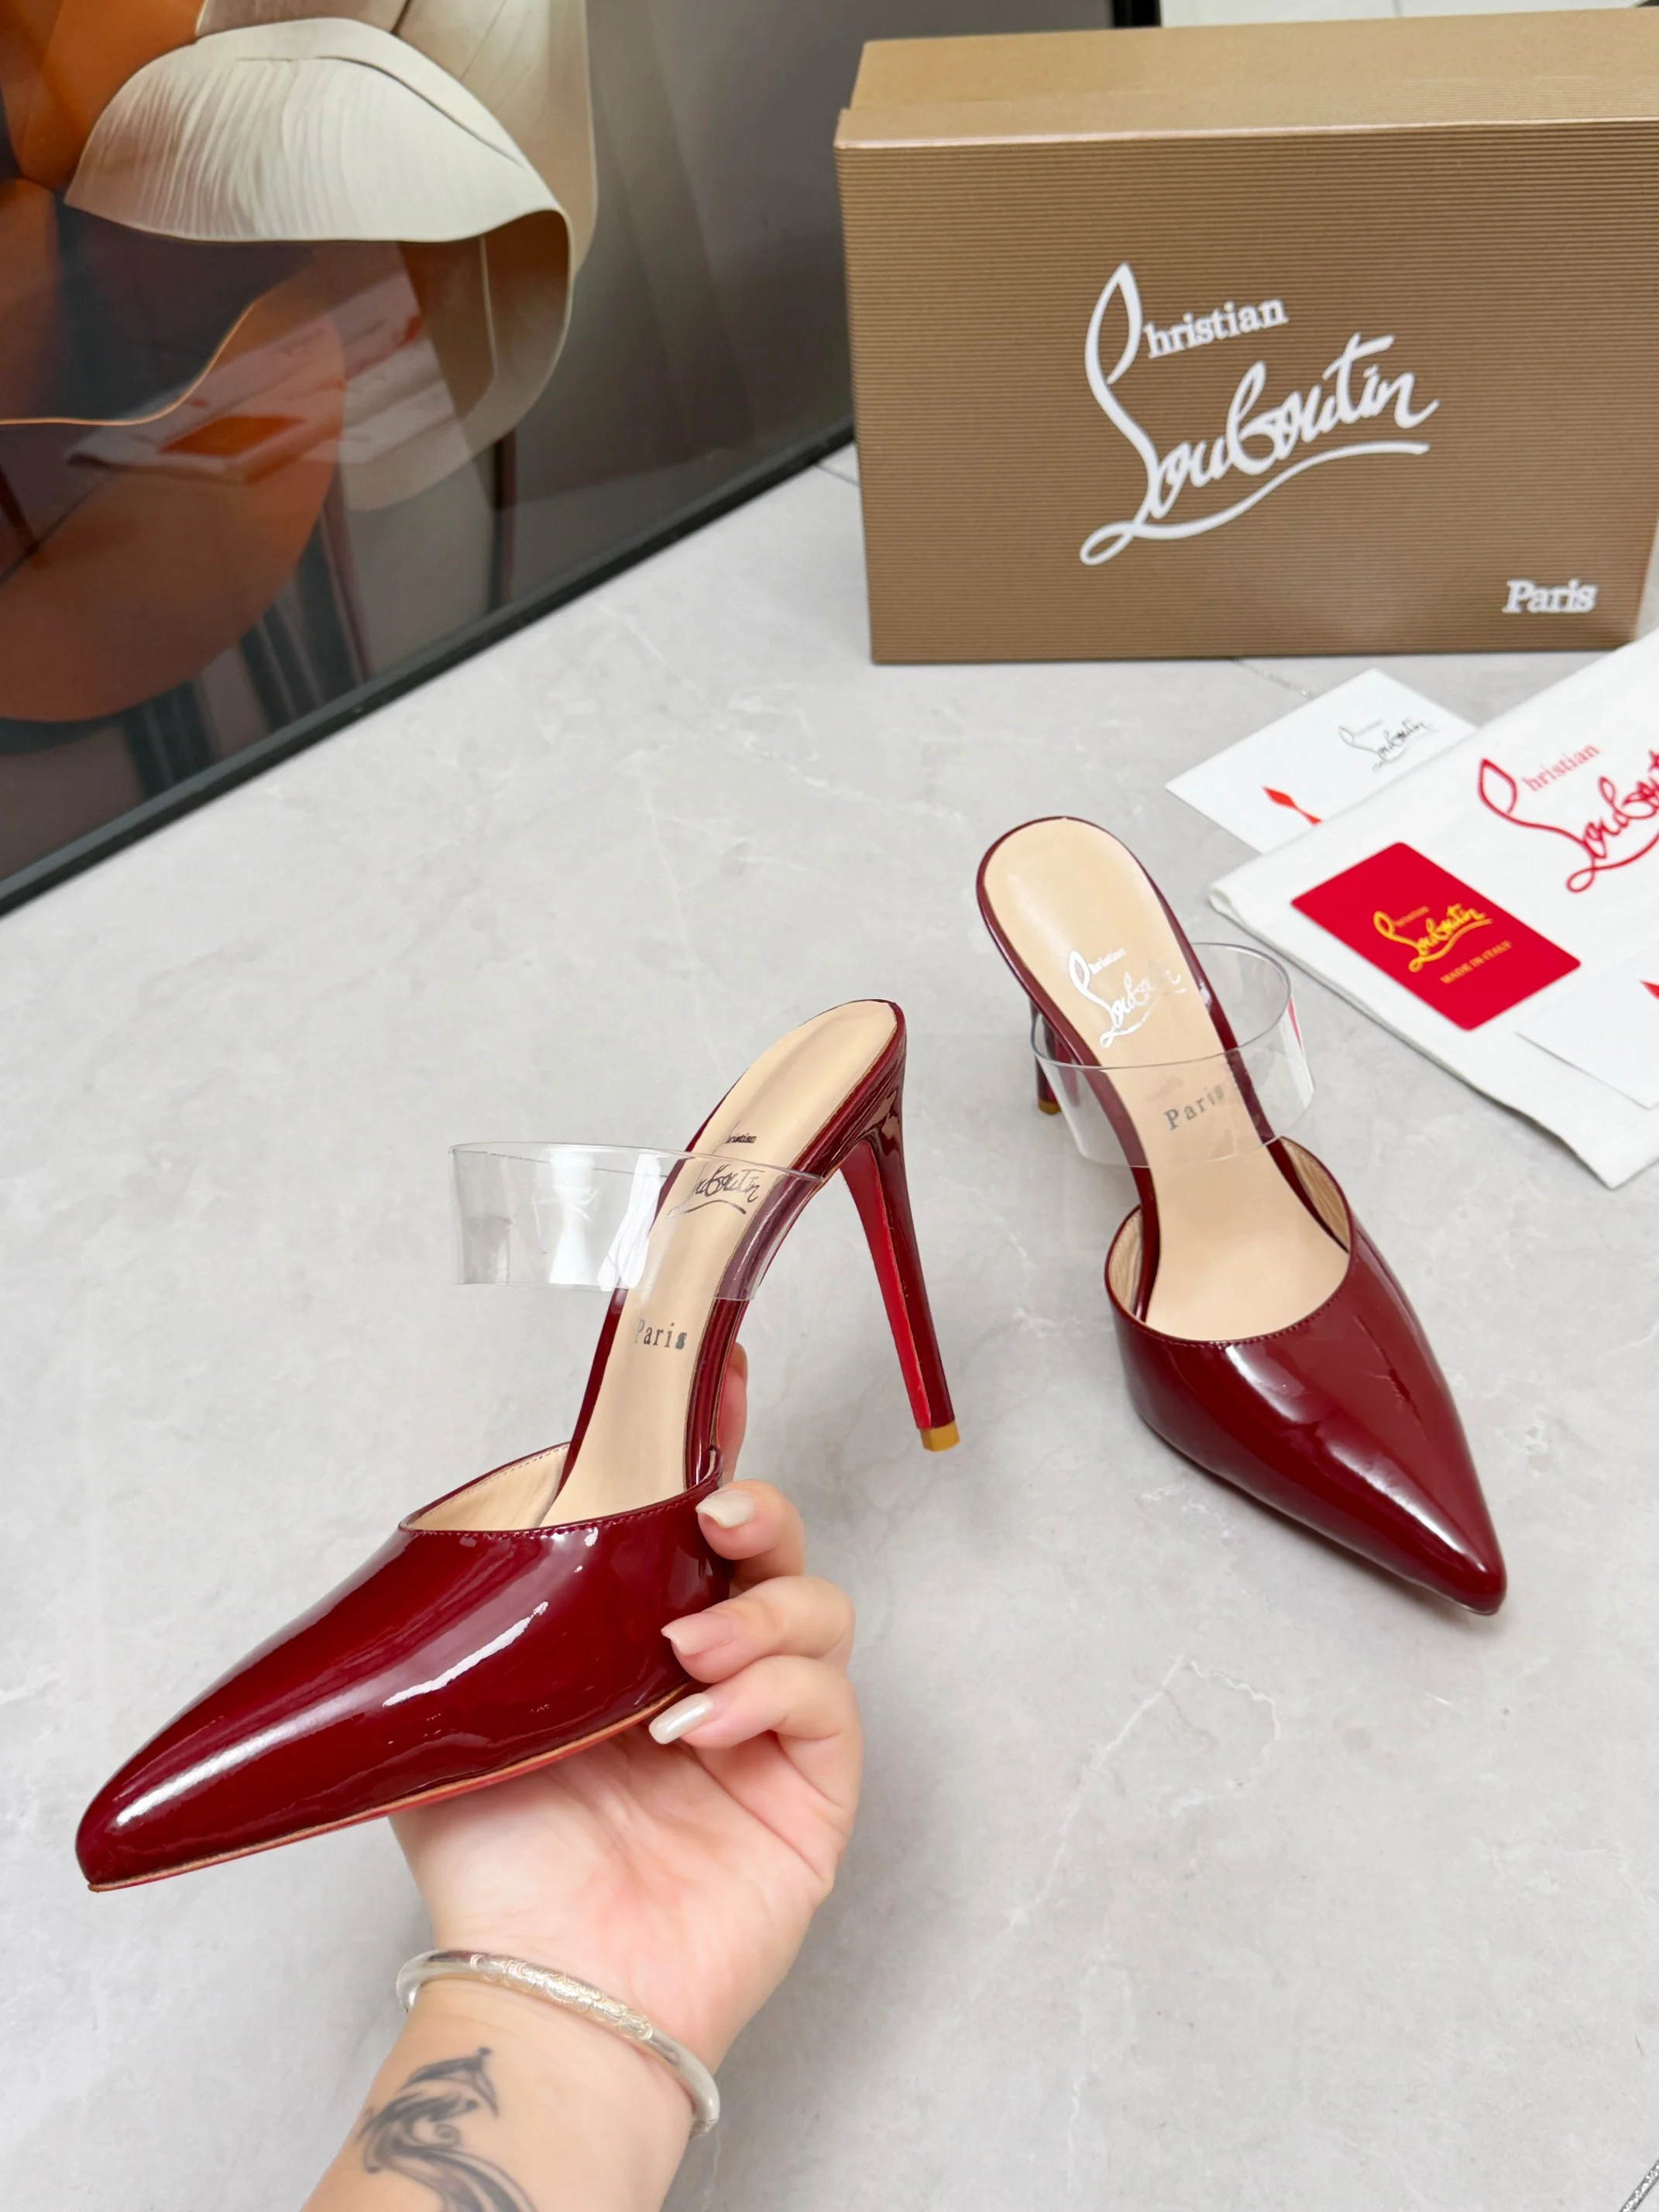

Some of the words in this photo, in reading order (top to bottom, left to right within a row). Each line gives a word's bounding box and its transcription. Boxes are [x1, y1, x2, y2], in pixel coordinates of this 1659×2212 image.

[1084, 262, 1289, 387] Christian
[1080, 331, 1441, 566] Louboutin
[1501, 578, 1598, 615] Paris
[1163, 1085, 1225, 1132] Paris
[635, 1318, 688, 1351] Paris
